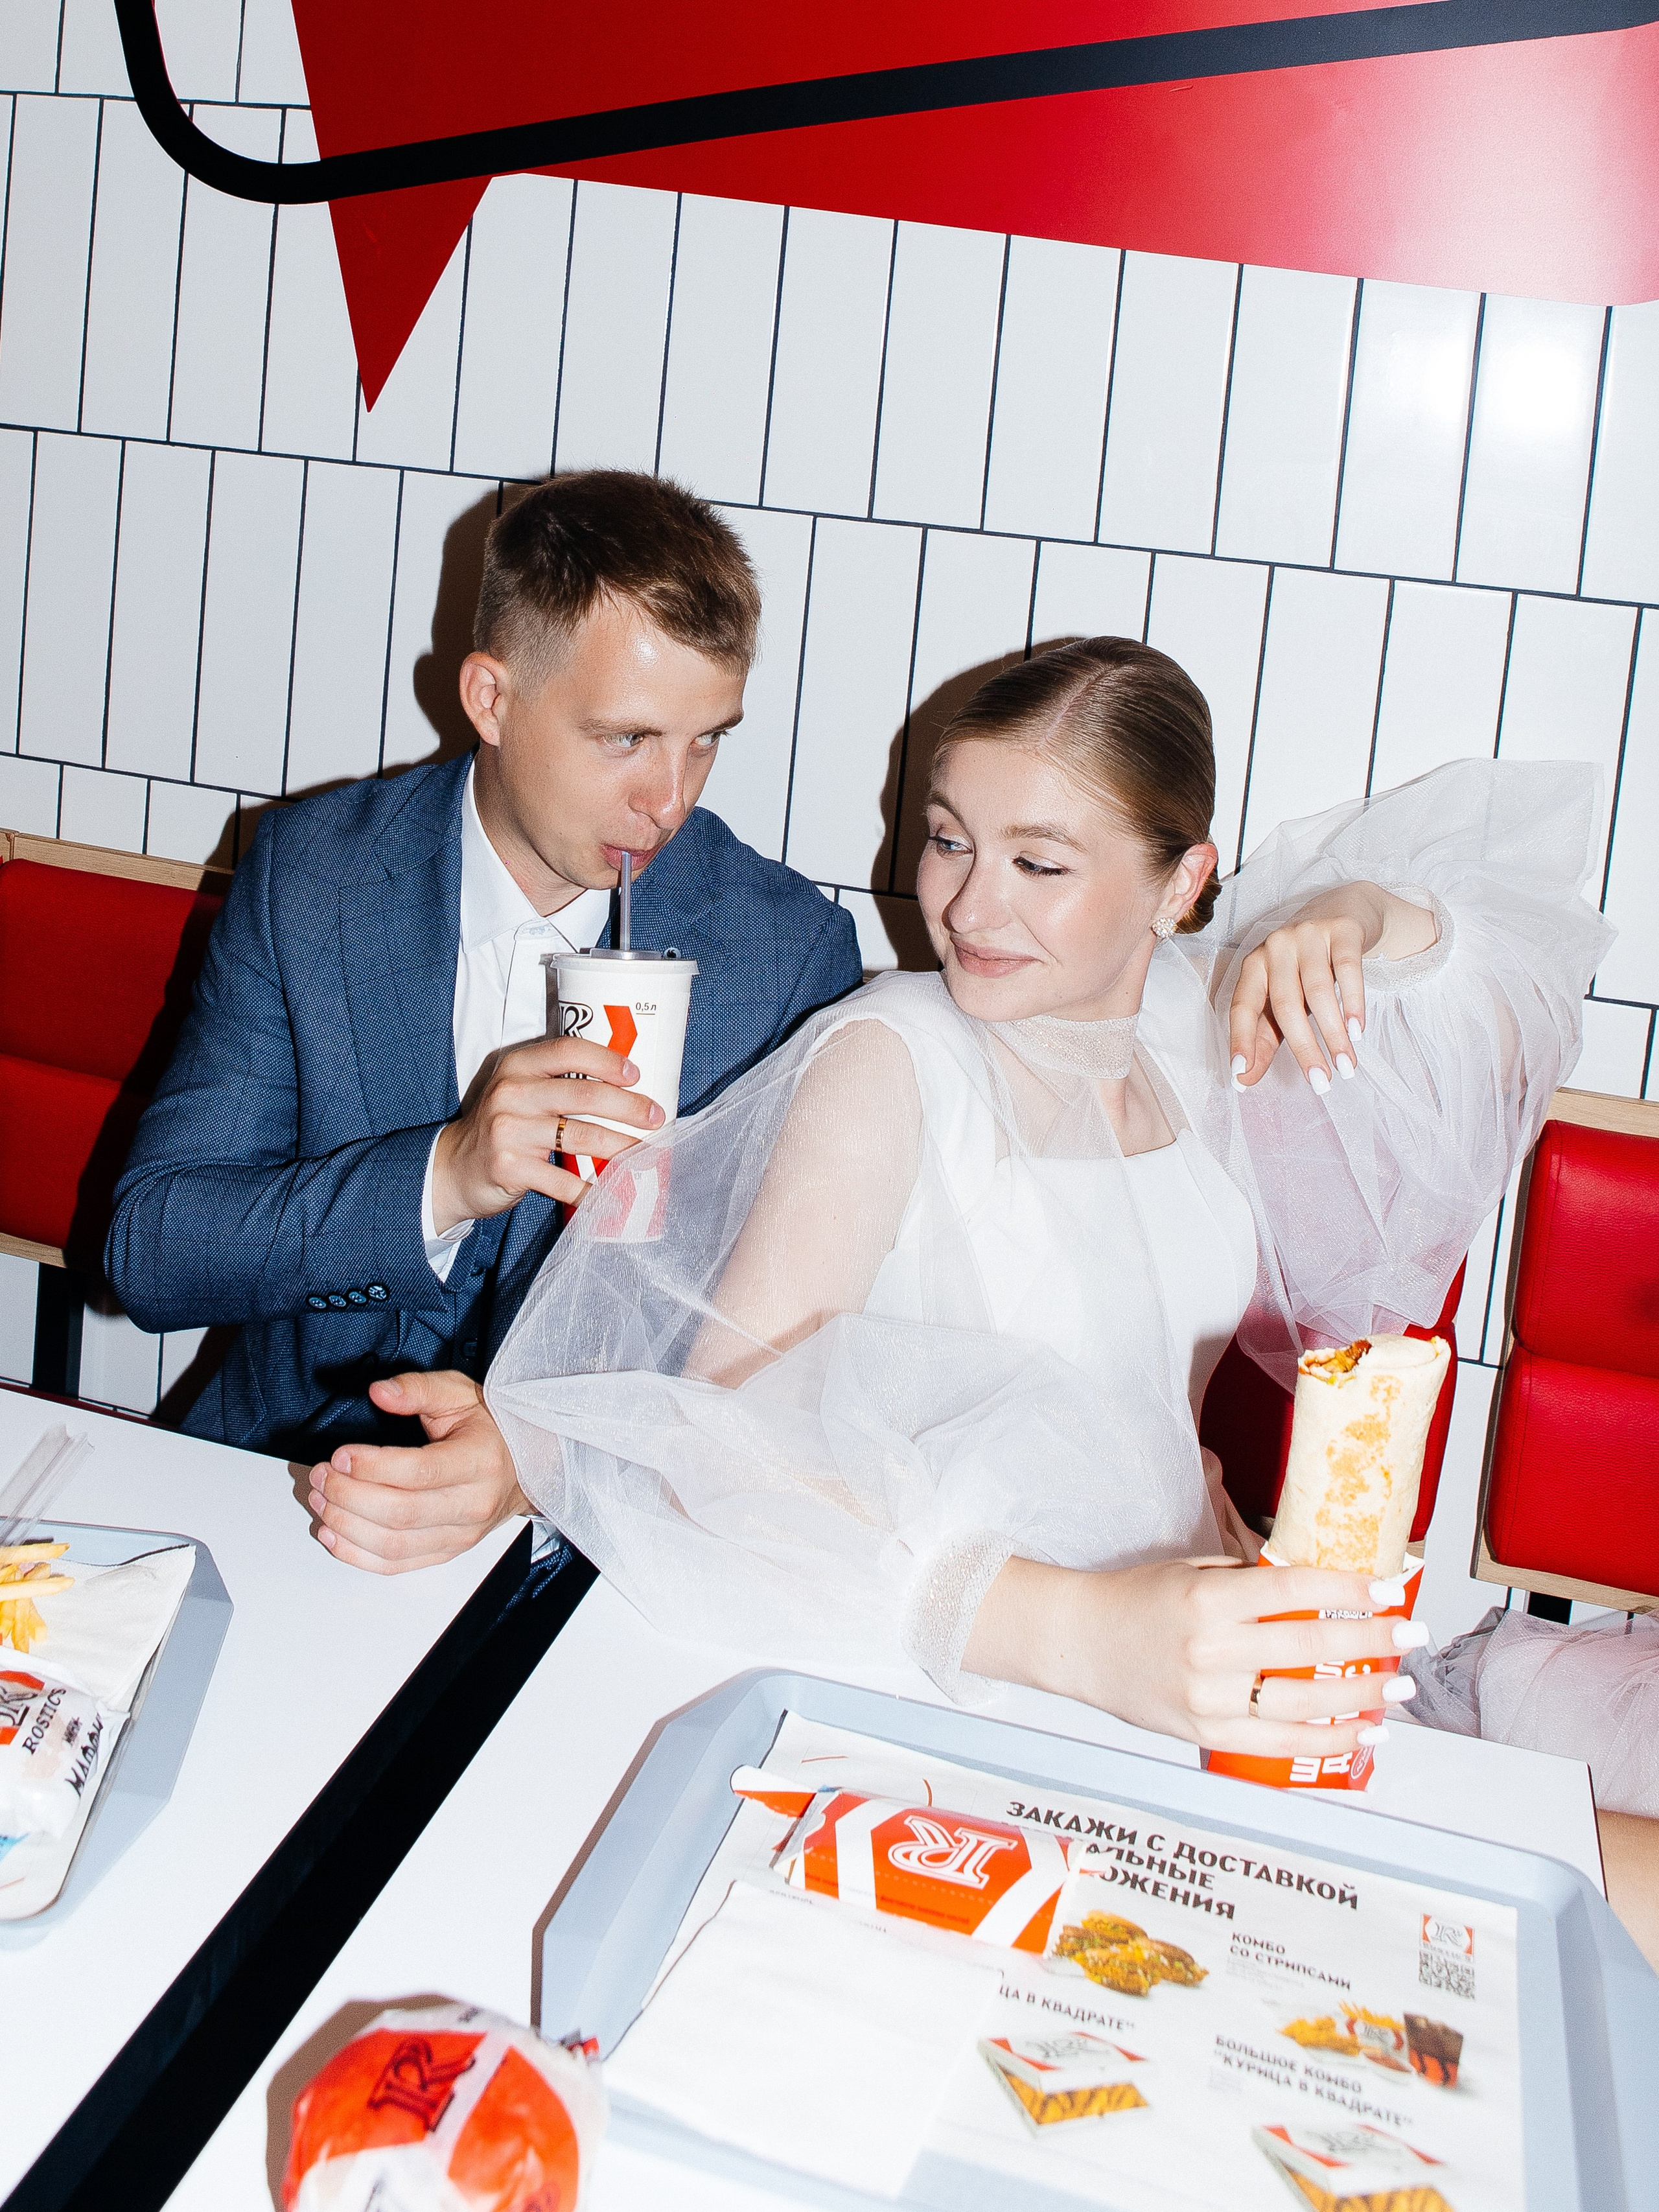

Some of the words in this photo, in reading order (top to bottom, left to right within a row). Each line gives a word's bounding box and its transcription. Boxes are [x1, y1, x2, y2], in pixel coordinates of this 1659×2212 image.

[635, 1002, 649, 1012] 0,5
[1006, 1801, 1138, 1846] ЗАКАЖИ
[1146, 1834, 1166, 1852] С
[1173, 1840, 1358, 1910] ДОСТАВКОЙ
[1085, 1843, 1216, 1891] АЛЬНЫЕ
[1099, 1865, 1236, 1920] ОЖЕНИЯ
[1232, 1931, 1286, 1955] КОМБО
[1230, 1944, 1249, 1957] СО
[1255, 1952, 1351, 1991] СТРИПСАМИ
[999, 1985, 1020, 1999] ЦА
[1216, 2034, 1297, 2072] БОЛЬШОЕ
[1304, 2065, 1362, 2093] КОМБО
